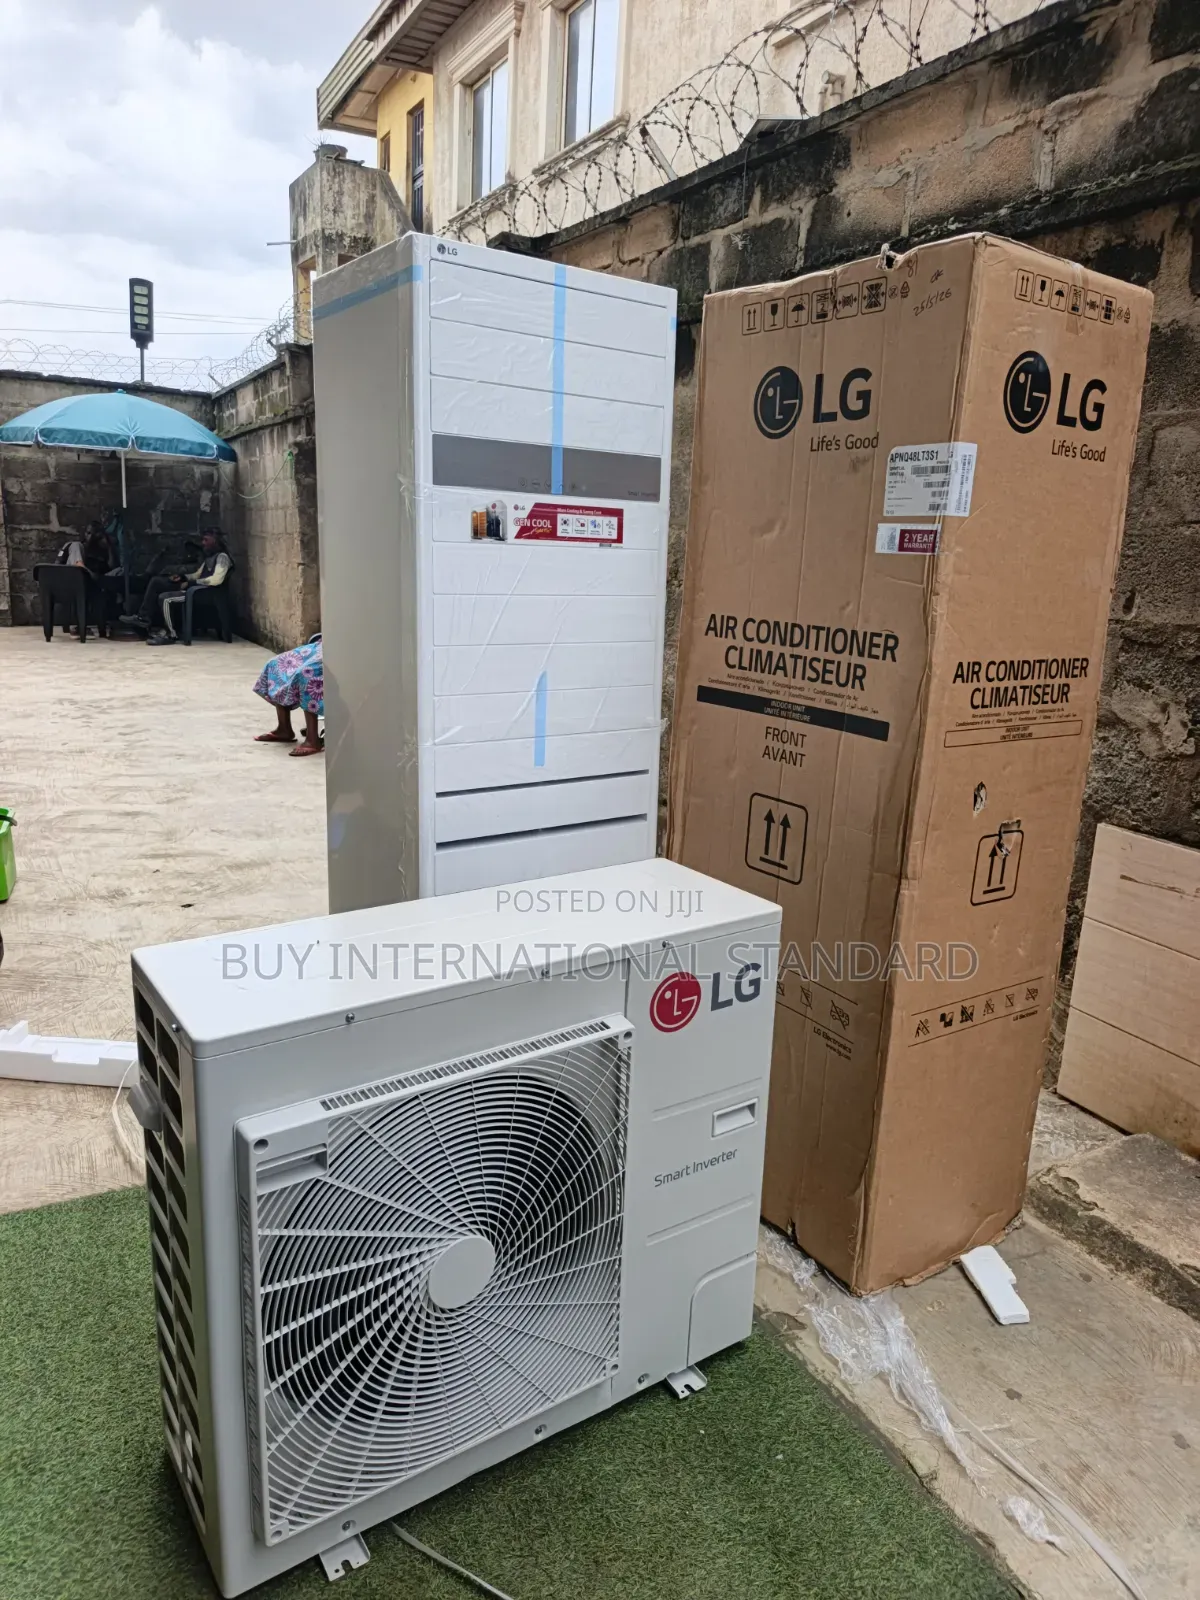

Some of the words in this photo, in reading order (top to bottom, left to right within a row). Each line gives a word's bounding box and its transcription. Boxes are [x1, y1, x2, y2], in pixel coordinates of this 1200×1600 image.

[447, 246, 458, 256] LG
[813, 367, 873, 424] LG
[1056, 372, 1108, 432] LG
[810, 435, 841, 452] Life's
[845, 432, 880, 450] Good
[1051, 439, 1077, 459] Life's
[1080, 443, 1107, 463] Good
[513, 517, 531, 527] GEN
[531, 518, 553, 528] COOL
[904, 533, 910, 542] 2
[912, 533, 935, 543] YEAR
[704, 613, 738, 641] AIR
[742, 616, 900, 663] CONDITIONER
[724, 644, 867, 692] CLIMATISEUR
[952, 661, 982, 684] AIR
[985, 656, 1090, 683] CONDITIONER
[770, 700, 792, 710] INDOOR
[793, 703, 806, 712] UNIT
[970, 682, 1071, 710] CLIMATISEUR
[764, 726, 807, 748] FRONT
[762, 745, 807, 768] AVANT
[710, 962, 762, 1012] LG
[813, 1026, 821, 1036] LG
[653, 1164, 691, 1188] Smart
[692, 1148, 738, 1174] Inverter
